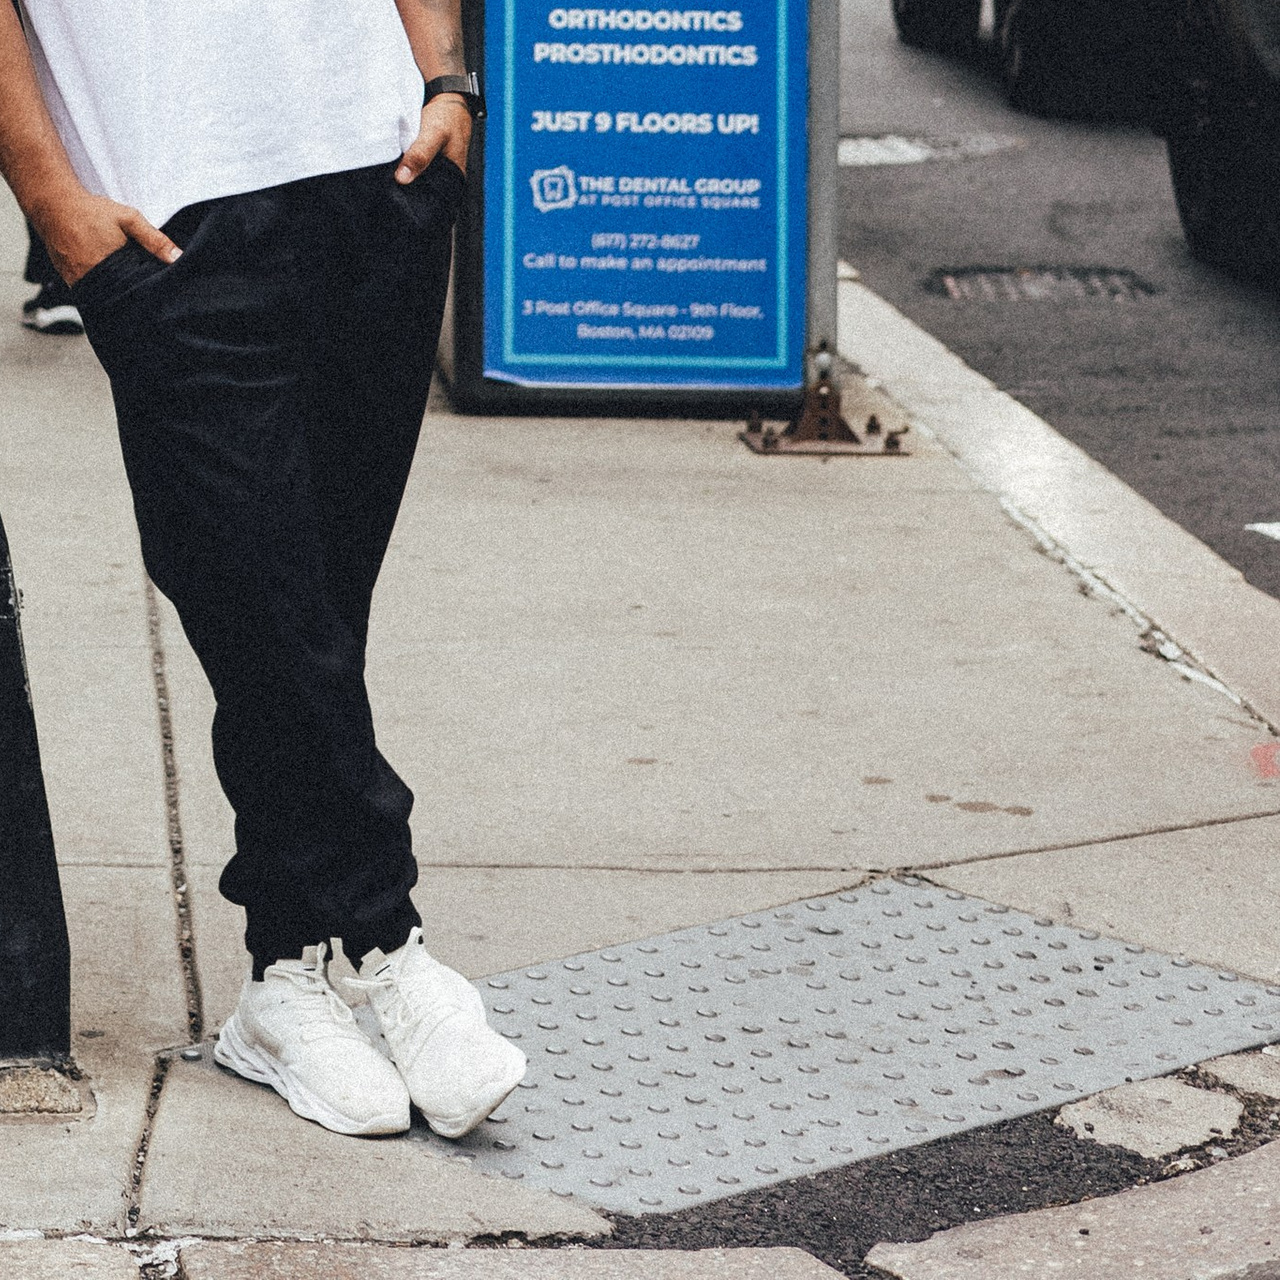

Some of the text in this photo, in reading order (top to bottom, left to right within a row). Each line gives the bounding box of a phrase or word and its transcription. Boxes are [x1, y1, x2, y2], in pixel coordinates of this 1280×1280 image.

[548, 8, 743, 32] ORTHODONTICS
[533, 42, 758, 66] PROSTHODONTICS
[530, 110, 760, 135] JUST 9 FLOORS UP!
[578, 175, 761, 195] THE DENTAL GROUP
[577, 194, 761, 210] AT POST OFFICE SQUARE
[523, 253, 767, 272] Call to make an appointment
[535, 300, 570, 316] Post
[573, 300, 620, 317] Office
[622, 301, 679, 318] Square
[638, 324, 666, 339] MA
